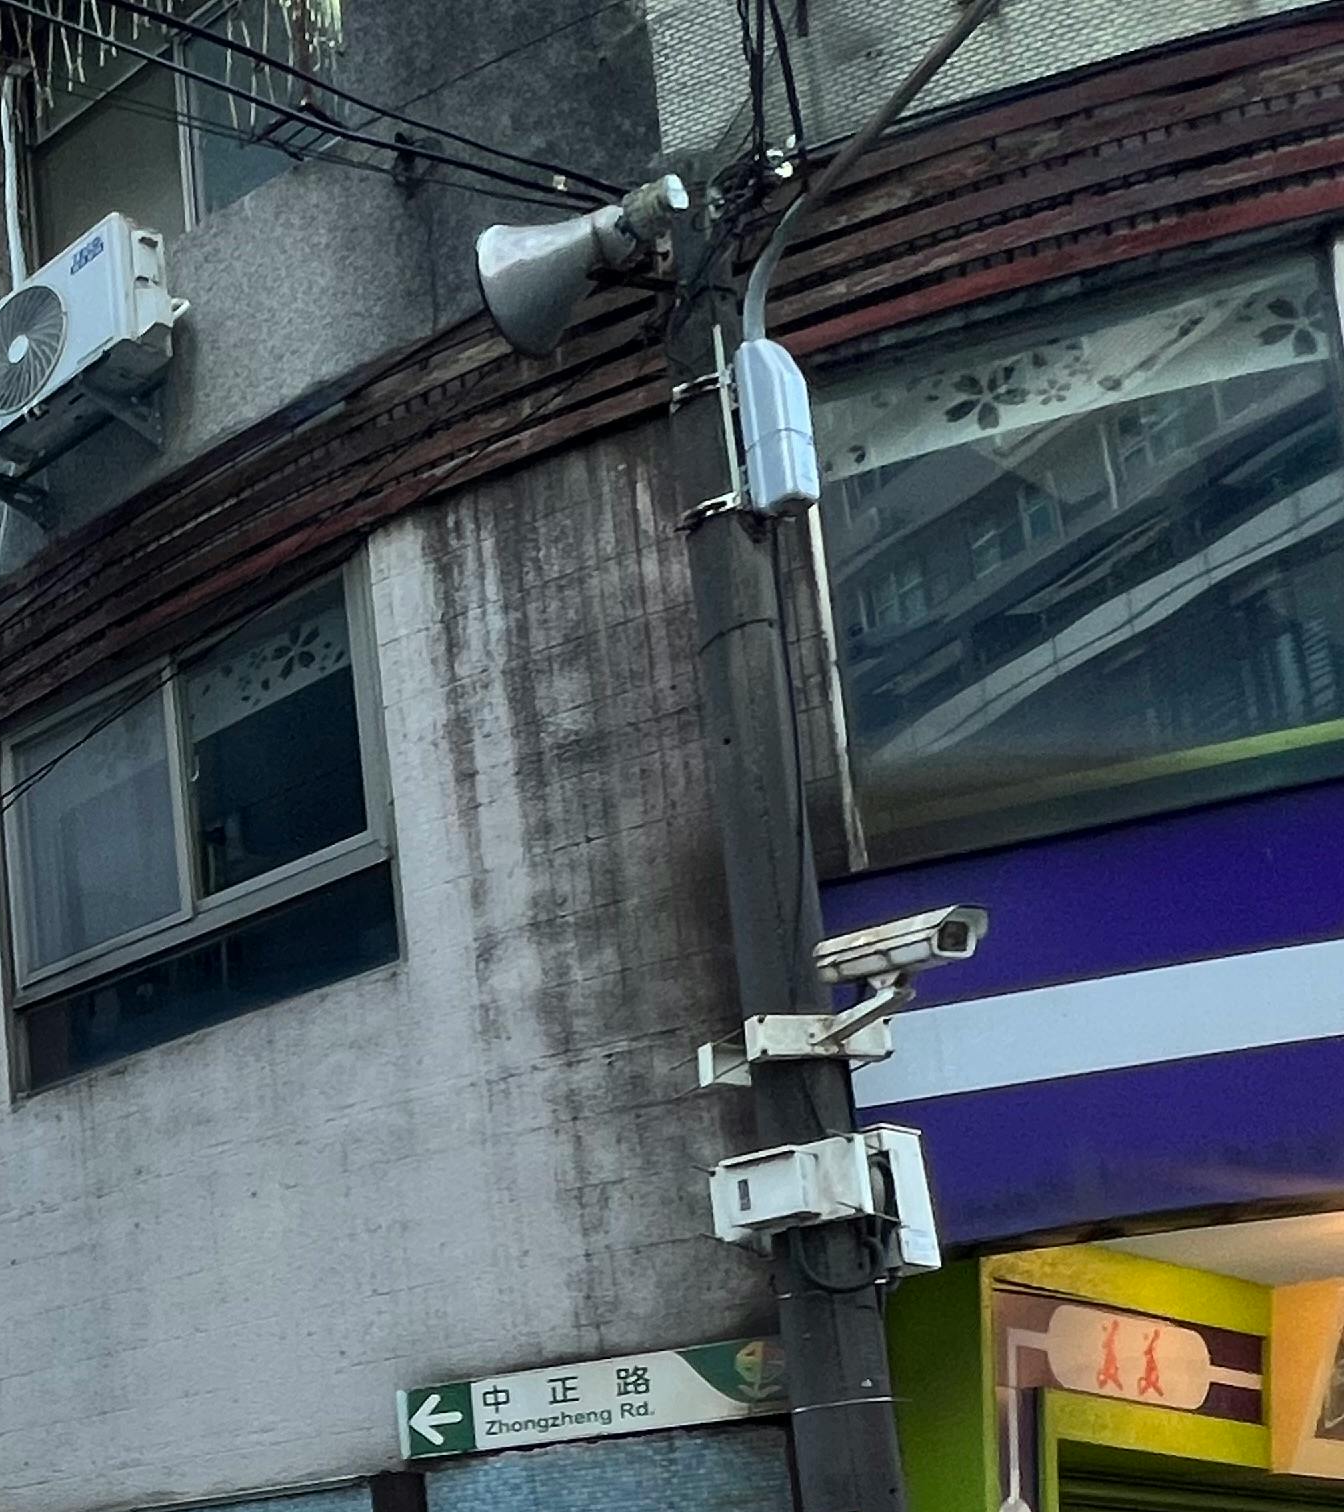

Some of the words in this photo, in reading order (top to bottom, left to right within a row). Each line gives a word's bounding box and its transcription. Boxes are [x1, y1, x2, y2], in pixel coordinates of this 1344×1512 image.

[481, 1365, 651, 1414] 中正路
[484, 1406, 613, 1437] Zhongzheng
